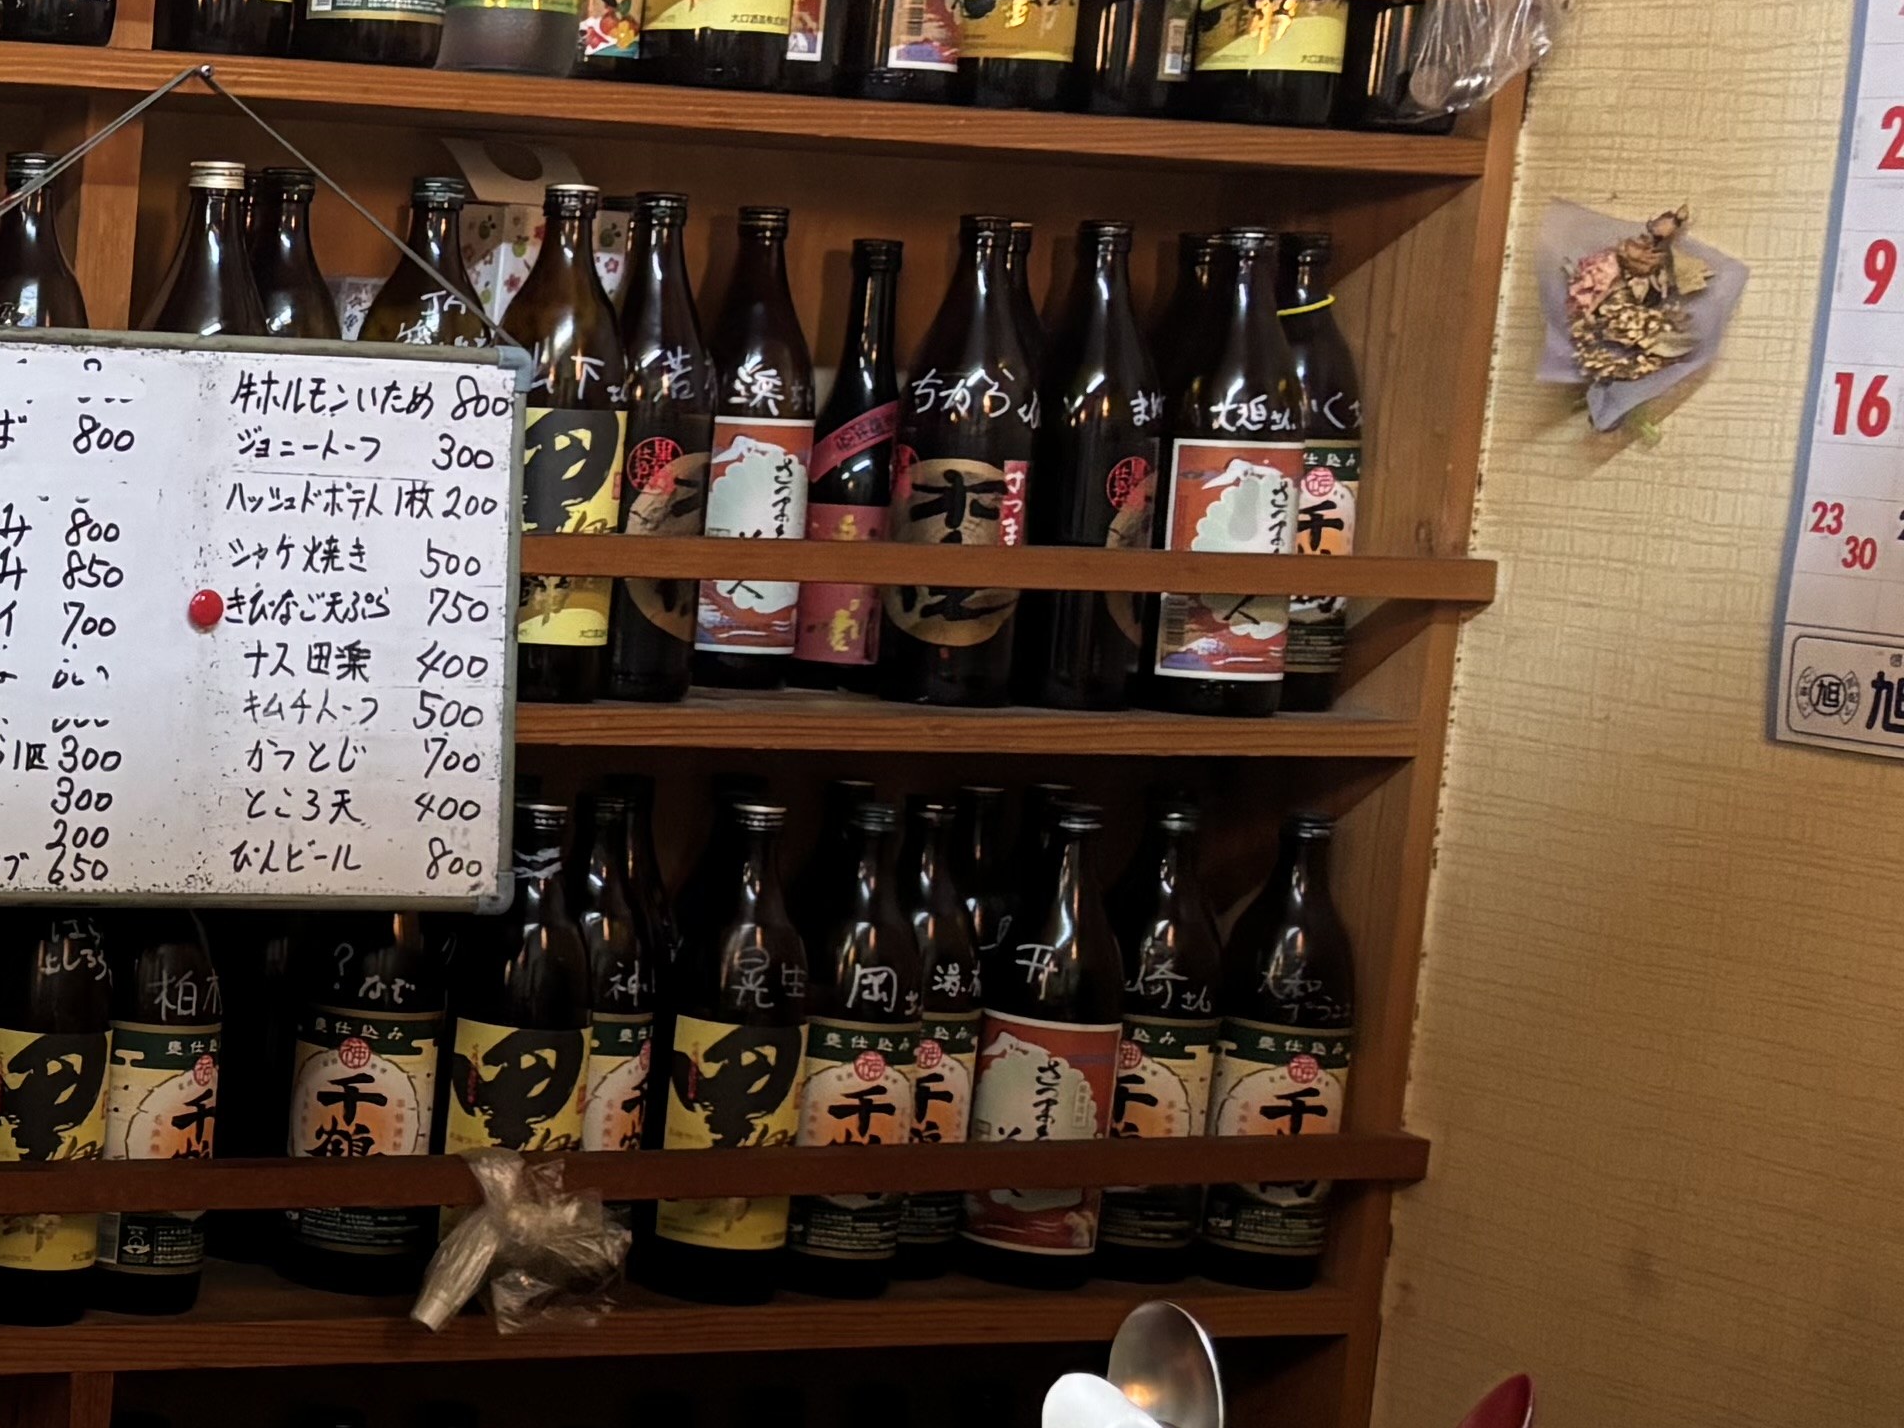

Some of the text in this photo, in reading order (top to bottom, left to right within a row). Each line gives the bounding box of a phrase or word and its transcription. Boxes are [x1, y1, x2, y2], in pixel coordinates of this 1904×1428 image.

[1863, 238, 1899, 306] 9
[450, 375, 512, 421] 800
[1832, 371, 1893, 439] 16
[72, 414, 135, 455] 800
[431, 433, 494, 471] 300
[441, 486, 498, 520] 200
[1808, 499, 1846, 537] 23
[64, 507, 120, 547] 800
[62, 549, 124, 590] 850
[421, 538, 481, 579] 500
[1841, 535, 1878, 570] 30
[61, 601, 117, 645] 700
[427, 587, 489, 626] 750
[416, 642, 489, 682] 400
[243, 689, 484, 730] キムチトーフ 500
[1815, 678, 1842, 709] 旭
[57, 736, 122, 774] 300
[424, 740, 481, 779] 700
[50, 776, 113, 815] 300
[244, 787, 481, 825] ところ天 400
[44, 818, 110, 853] 200
[45, 844, 109, 886] 650
[426, 836, 483, 881] 800
